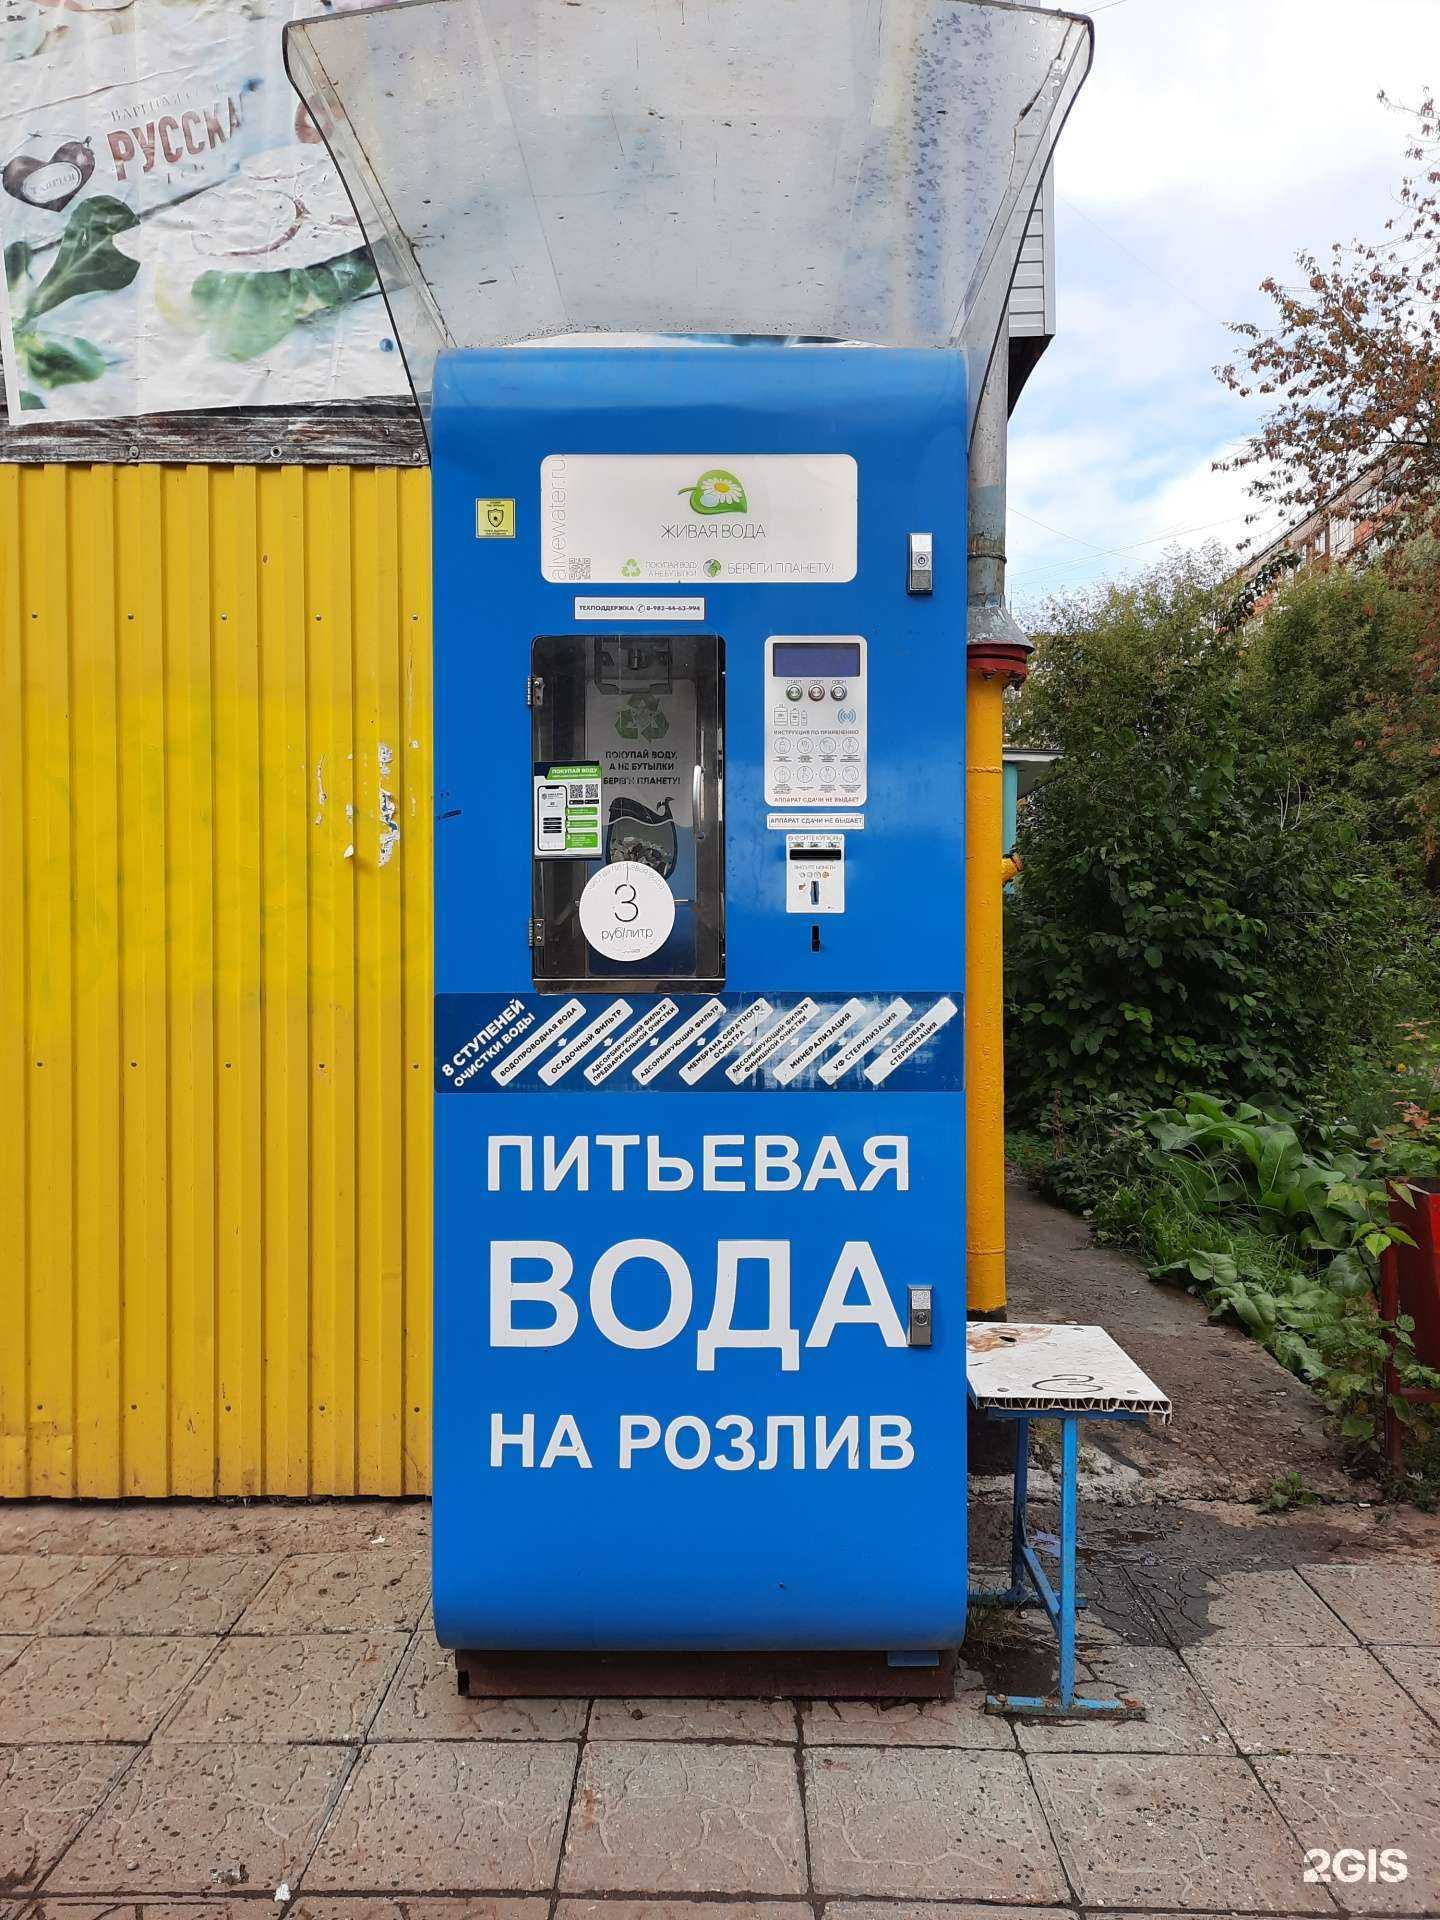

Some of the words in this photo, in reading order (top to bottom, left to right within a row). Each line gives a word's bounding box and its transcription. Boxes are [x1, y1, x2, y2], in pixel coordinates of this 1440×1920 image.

[548, 457, 566, 581] alivewater.ru
[661, 523, 718, 539] ЖИВАЯ
[721, 523, 767, 540] ВОДА
[728, 562, 773, 575] БЕРЕГИ
[777, 562, 834, 575] ПЛАНЕТУ!
[605, 749, 649, 759] ПОКУПАЙ
[651, 751, 678, 760] ВОДУ,
[609, 763, 616, 771] А
[631, 763, 674, 771] БУТЫЛКИ
[614, 883, 639, 923] 3
[601, 927, 653, 940] руб/литр
[441, 1063, 454, 1077] 8
[453, 998, 526, 1067] СТУПЕНЕЙ
[499, 1023, 559, 1077] ВОДОПРОВОДНАЯ
[557, 1007, 578, 1025] ВОДА
[551, 1033, 595, 1074] ОСАДОЧНЫЙ
[594, 1009, 622, 1036] ФИЛЬТР
[591, 1023, 645, 1074] АДСОРБИРУЮЩИЙ
[643, 1003, 667, 1027] ФИЛЬТР
[640, 1026, 695, 1079] АДСОРБИРУЮЩИЙ
[694, 1005, 720, 1028] ФИЛЬТР
[687, 1038, 723, 1072] МЕМБРАНА
[722, 1004, 760, 1040] ОБРАТНОГО
[779, 1015, 808, 1041] ОЧИСТКИ
[785, 1003, 809, 1026] ФИЛЬТР
[789, 1012, 852, 1070] МИНЕРАЛИЗАЦИЯ
[832, 1057, 845, 1071] УФ
[844, 1012, 898, 1061] СТЕРИЛИЗАЦИЯ
[891, 1022, 926, 1054] ОЗОНОВАЯ
[454, 1040, 504, 1087] ОЧИСТКИ
[503, 1012, 536, 1045] ВОДЫ
[593, 1029, 649, 1082] ПРЕДВАРИТЕЛЬНОЙ
[647, 1006, 676, 1032] ОЧИСТКИ
[889, 1021, 938, 1067] СТЕРИЛИЗАЦИЯ
[487, 1135, 909, 1192] ПИТЬЕВАЯ
[490, 1238, 909, 1371] ВОДА
[490, 1413, 593, 1468] НА
[618, 1414, 916, 1471] РОЗЛИВ
